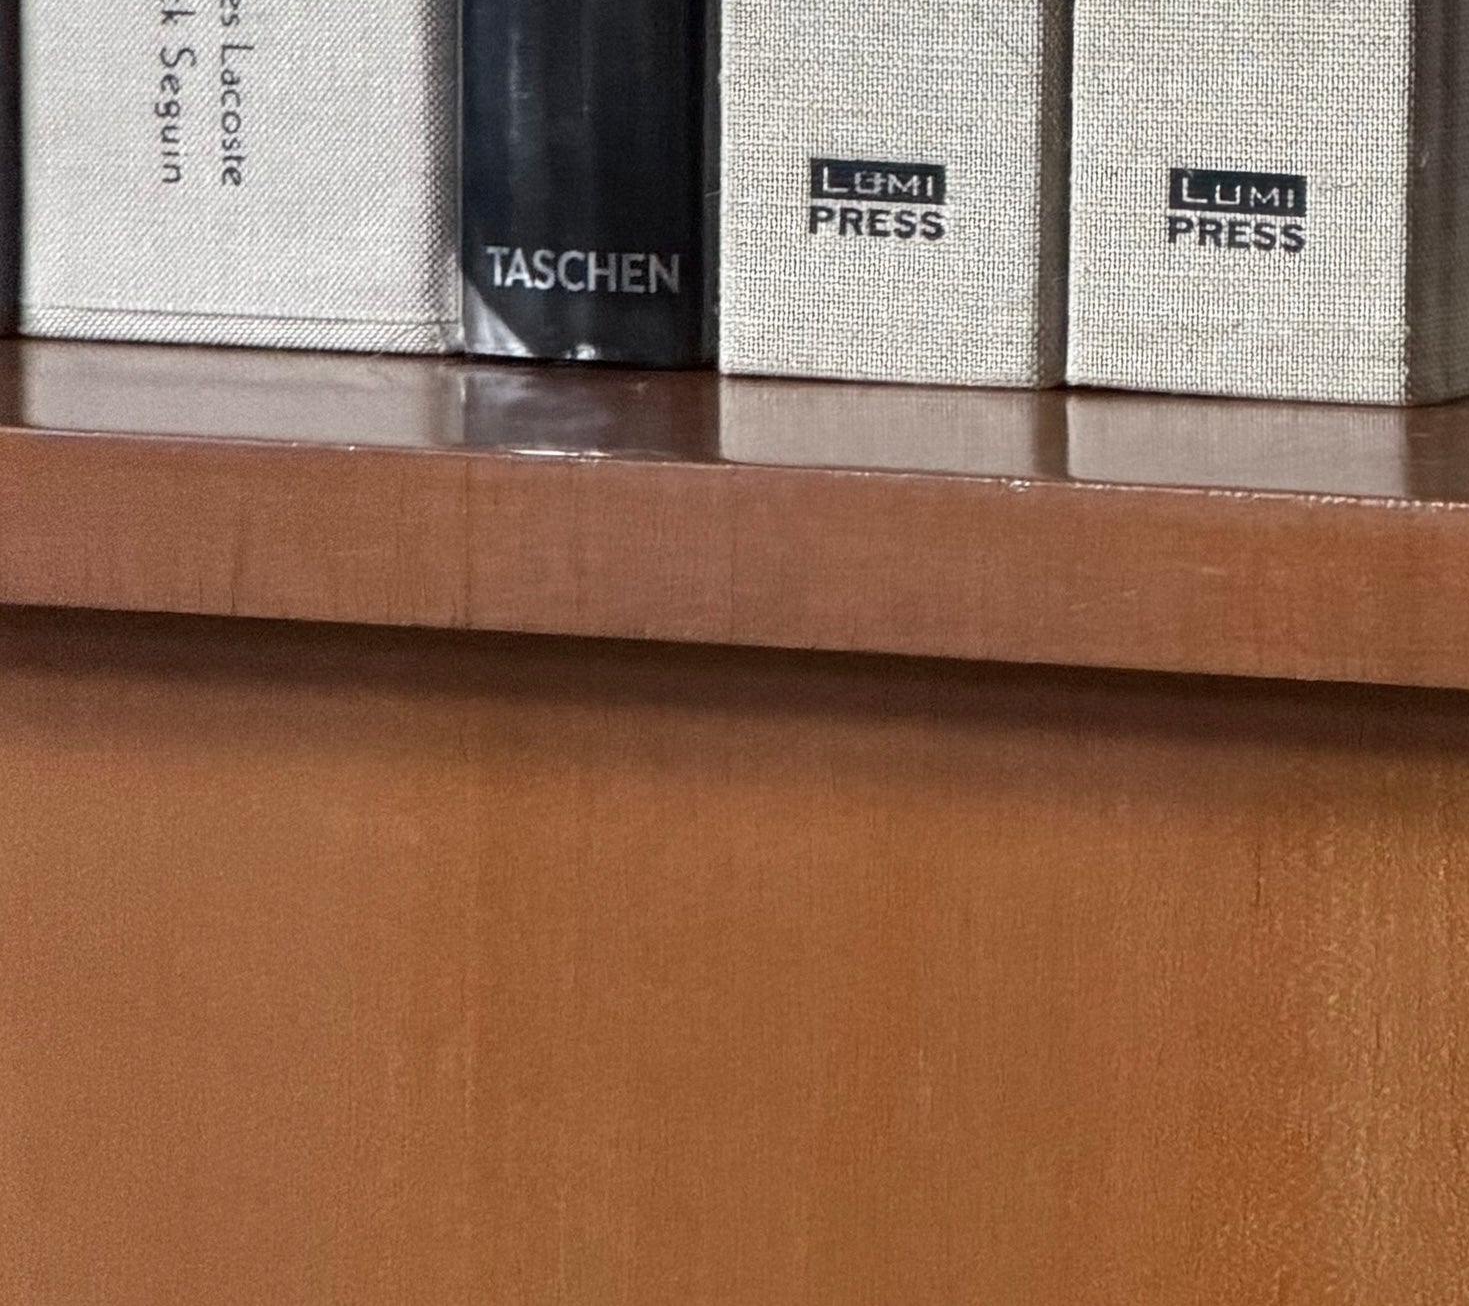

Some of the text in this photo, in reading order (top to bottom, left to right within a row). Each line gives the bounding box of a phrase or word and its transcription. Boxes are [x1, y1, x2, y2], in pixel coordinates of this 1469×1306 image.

[154, 46, 198, 185] Seguin
[218, 43, 255, 188] Lacoste
[820, 163, 939, 199] LUMI
[1179, 173, 1299, 211] LUMI
[808, 206, 946, 241] PRESS
[1166, 215, 1305, 255] PRESS
[485, 245, 682, 294] TASCHEN
